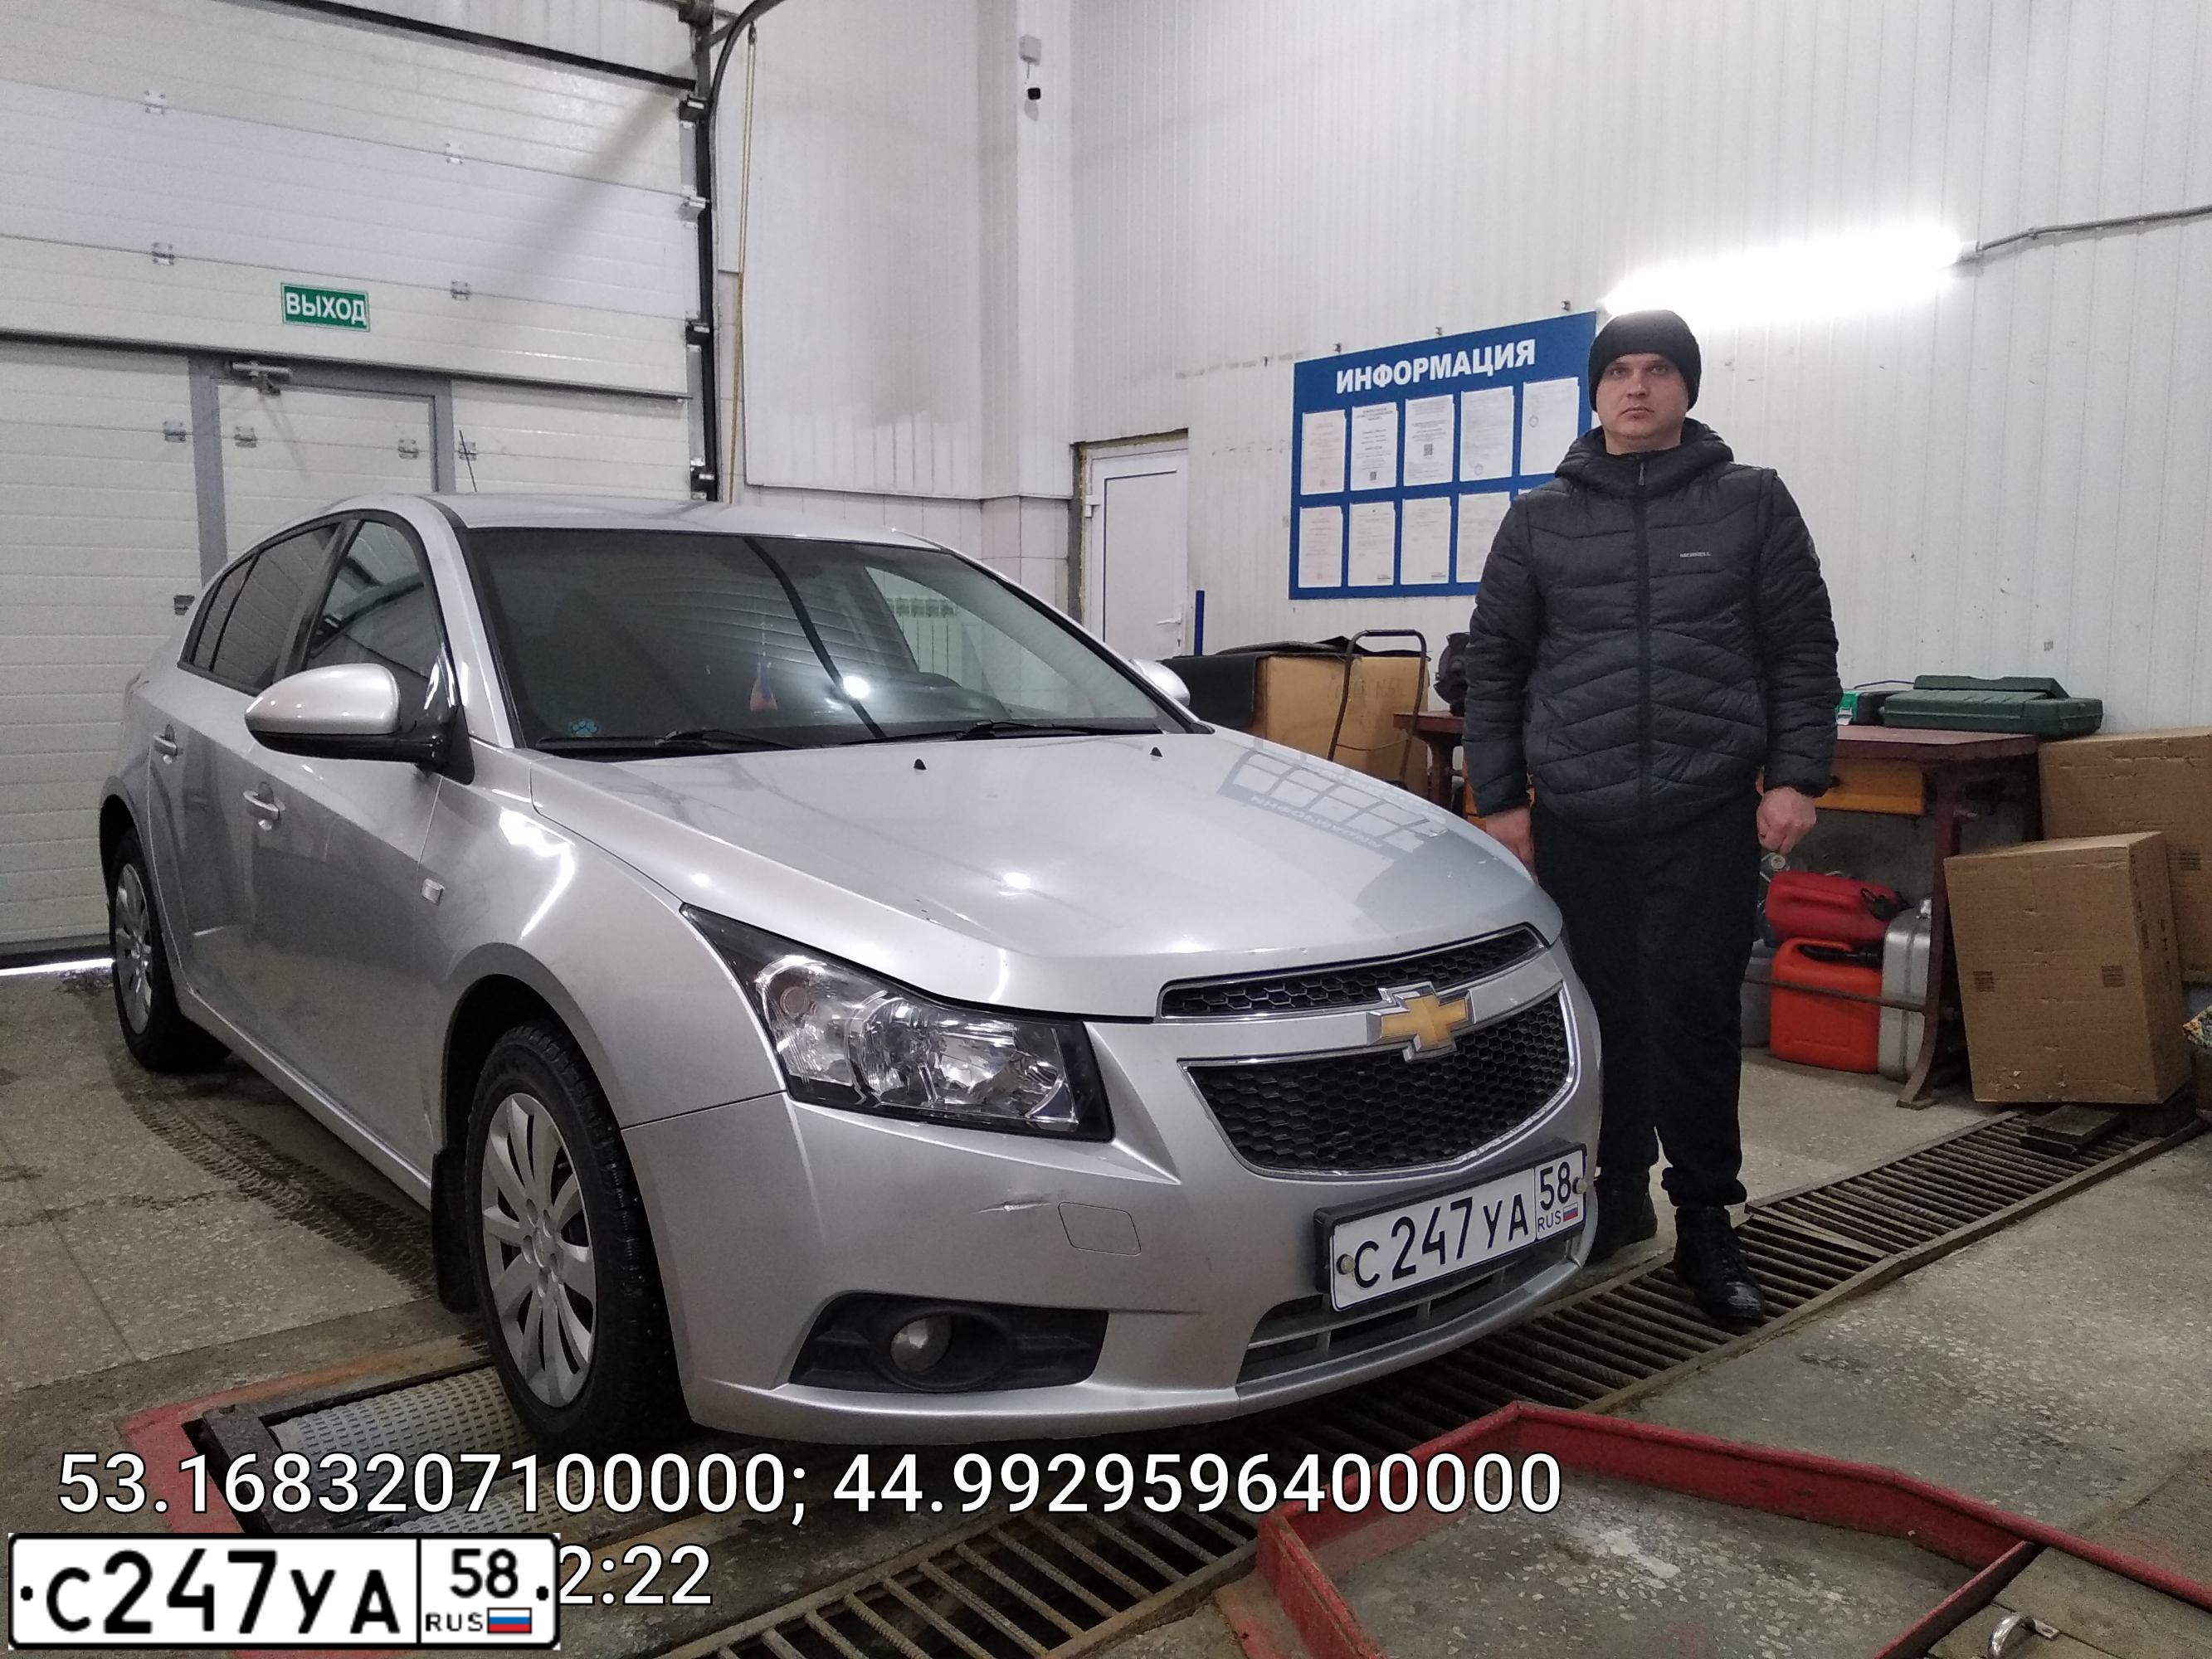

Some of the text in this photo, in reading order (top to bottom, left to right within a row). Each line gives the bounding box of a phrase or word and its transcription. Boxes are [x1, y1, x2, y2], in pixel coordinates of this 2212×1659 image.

[285, 292, 367, 325] ВЫХОД
[1336, 338, 1536, 394] ИНФОРМАЦИЯ
[1539, 1160, 1571, 1211] 58
[1537, 1209, 1562, 1233] RUS
